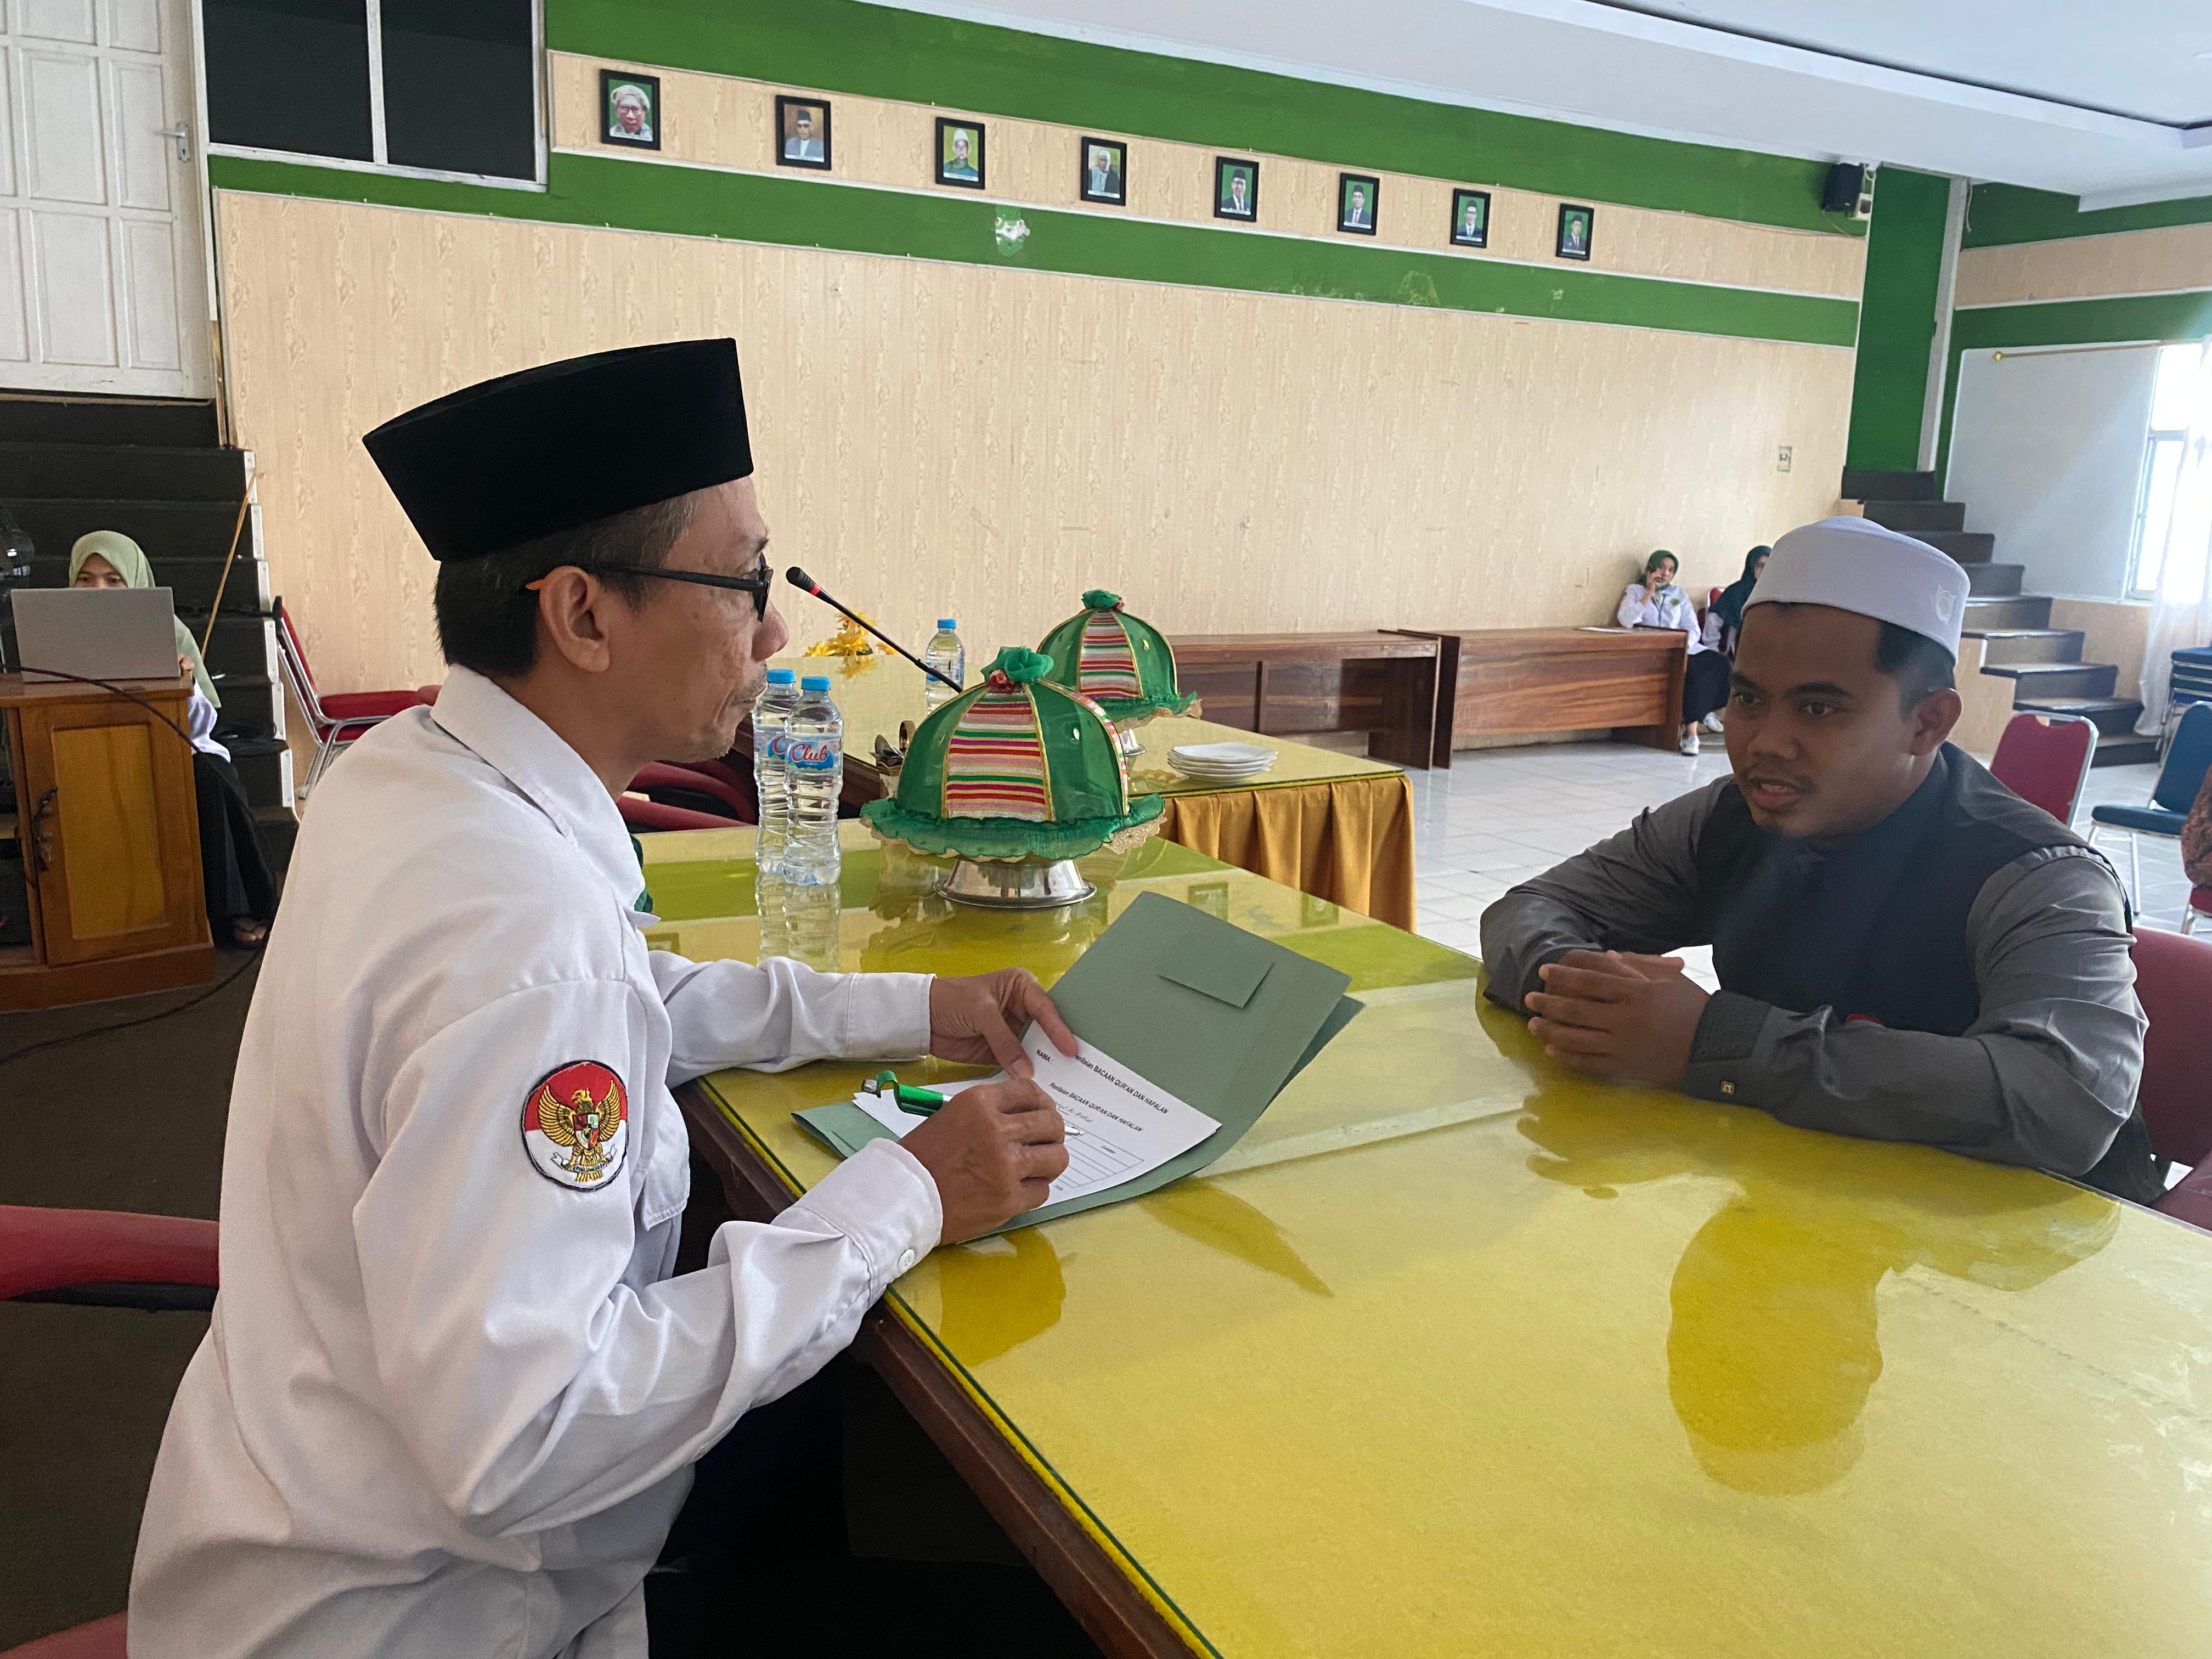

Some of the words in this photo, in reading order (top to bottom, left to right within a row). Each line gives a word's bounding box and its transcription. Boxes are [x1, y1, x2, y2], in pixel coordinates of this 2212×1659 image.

[791, 743, 828, 761] Club
[1036, 1049, 1051, 1062] NAMA
[1093, 1065, 1115, 1082] BACAAN
[1114, 1079, 1135, 1094] QUR'AN
[1133, 1091, 1146, 1101] DAN
[1144, 1097, 1169, 1114] HAFALAN
[1068, 1092, 1090, 1105] BACAAN
[1107, 1112, 1120, 1120] DAN
[1117, 1118, 1143, 1132] HAFALAN
